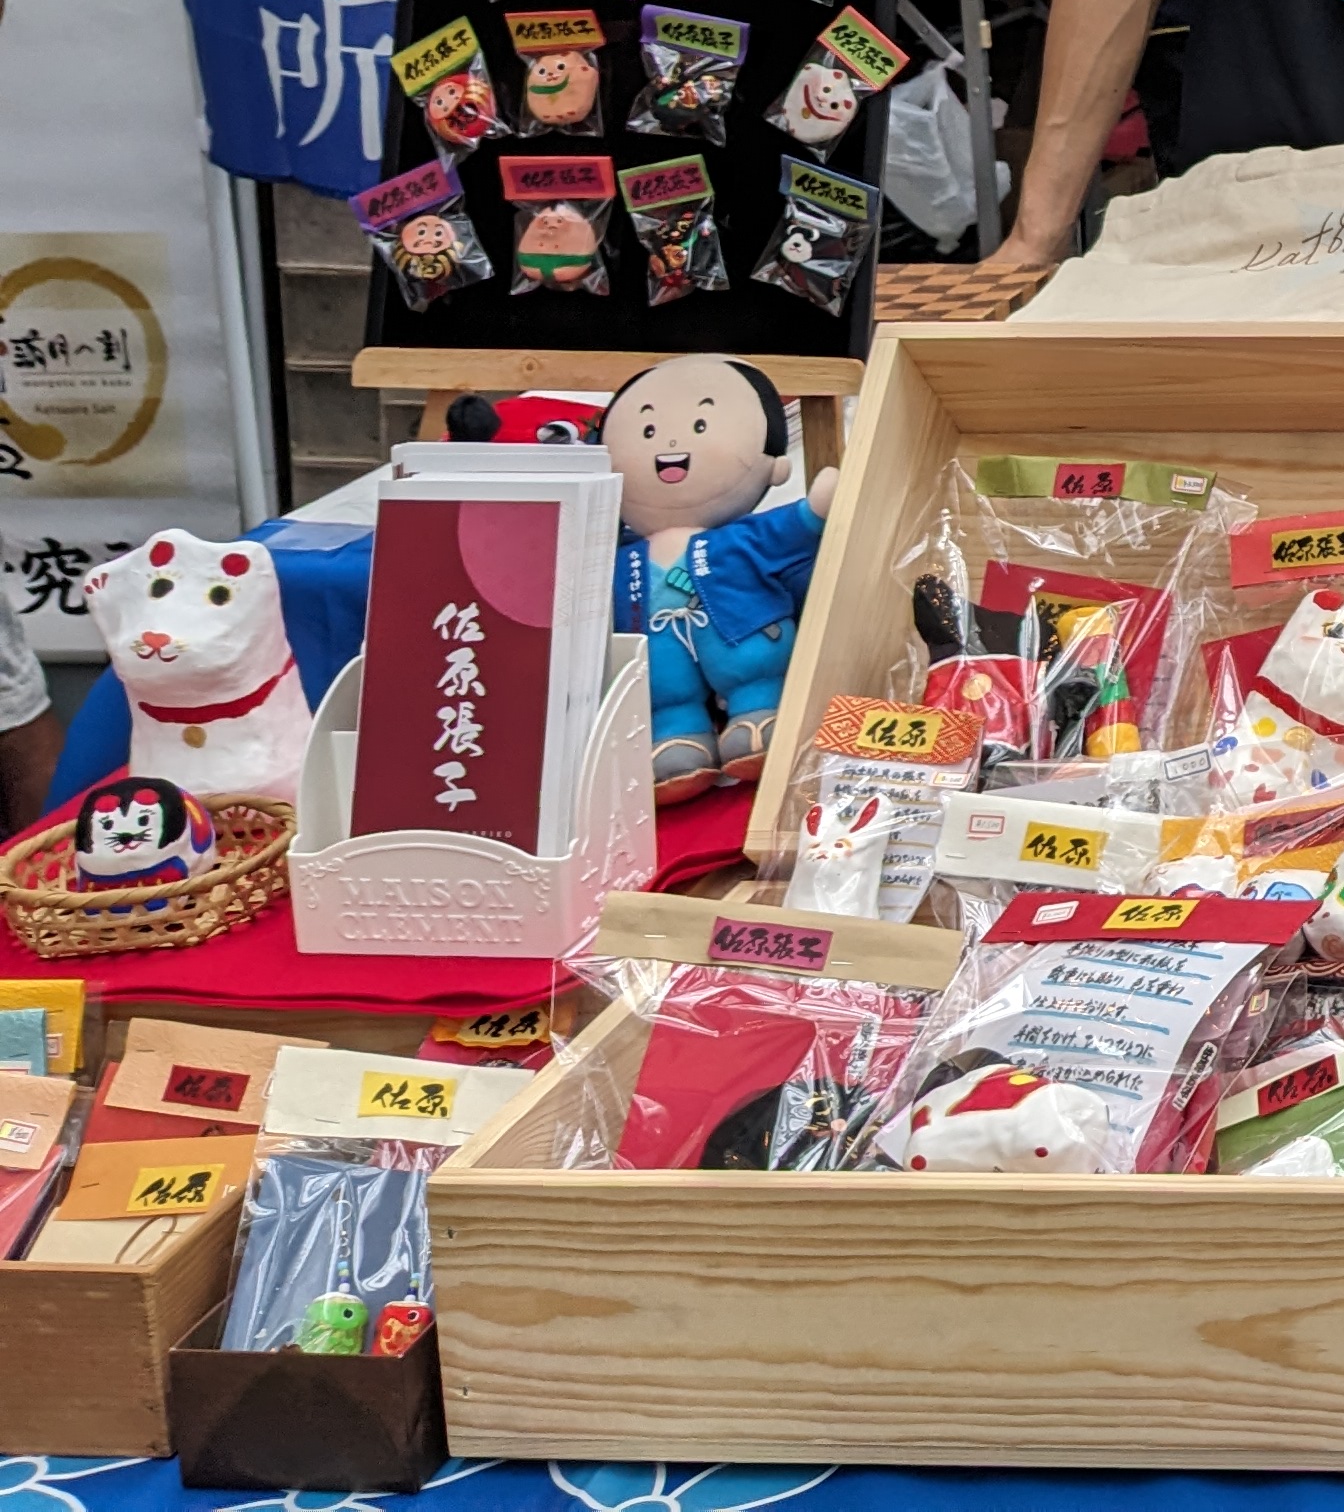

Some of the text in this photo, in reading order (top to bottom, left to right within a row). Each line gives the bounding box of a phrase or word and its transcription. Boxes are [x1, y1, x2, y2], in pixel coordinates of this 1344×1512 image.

[430, 601, 488, 813] 佐原張子
[864, 717, 929, 748] 佐原
[1026, 832, 1091, 866] 佐原
[368, 1078, 450, 1120] 佐原
